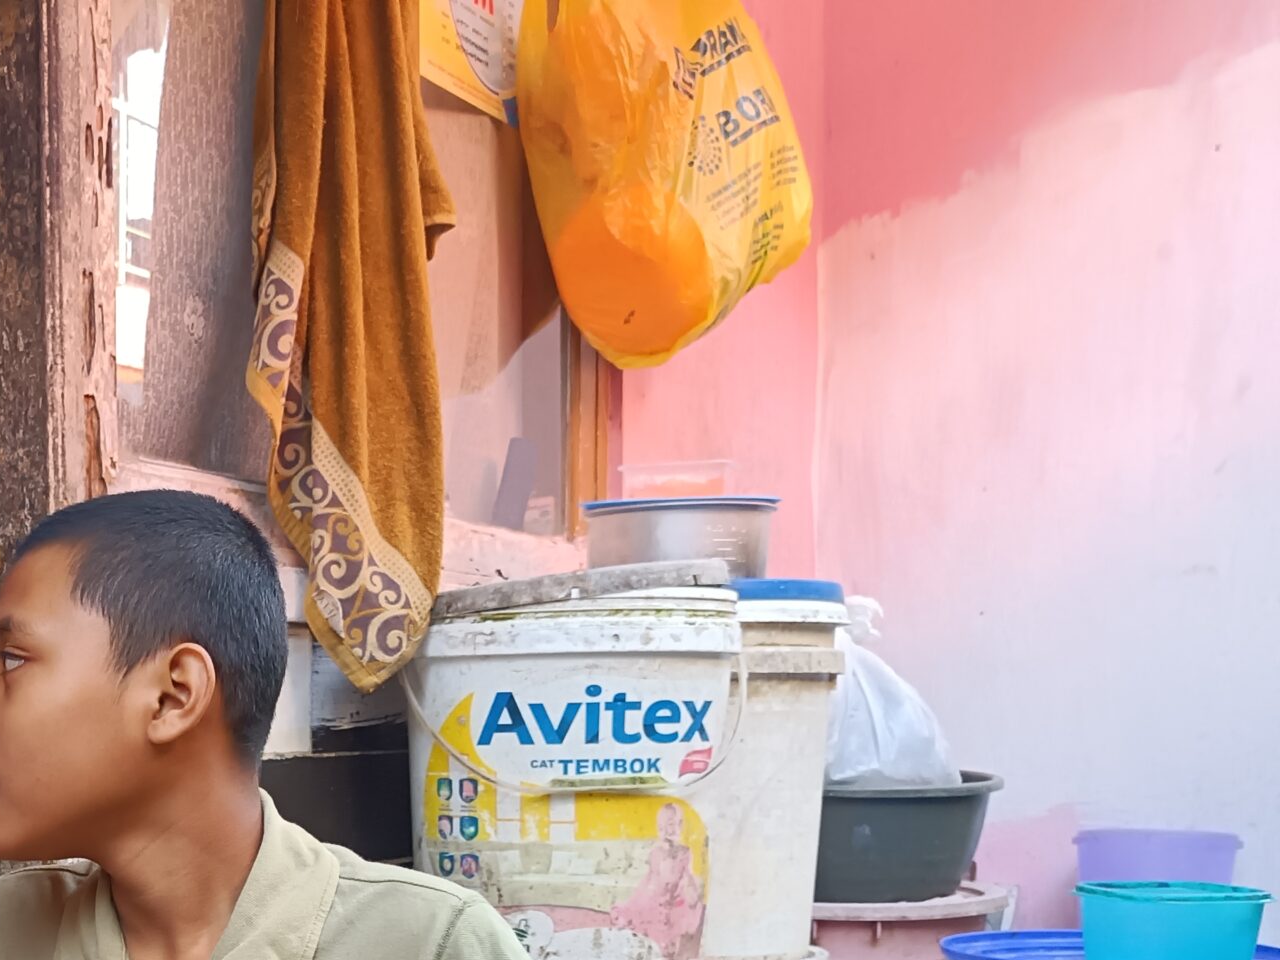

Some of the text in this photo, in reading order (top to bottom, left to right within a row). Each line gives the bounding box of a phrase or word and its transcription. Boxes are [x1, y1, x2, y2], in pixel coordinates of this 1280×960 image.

[476, 684, 713, 746] Avitex
[530, 757, 661, 776] CAT TEMBOK
